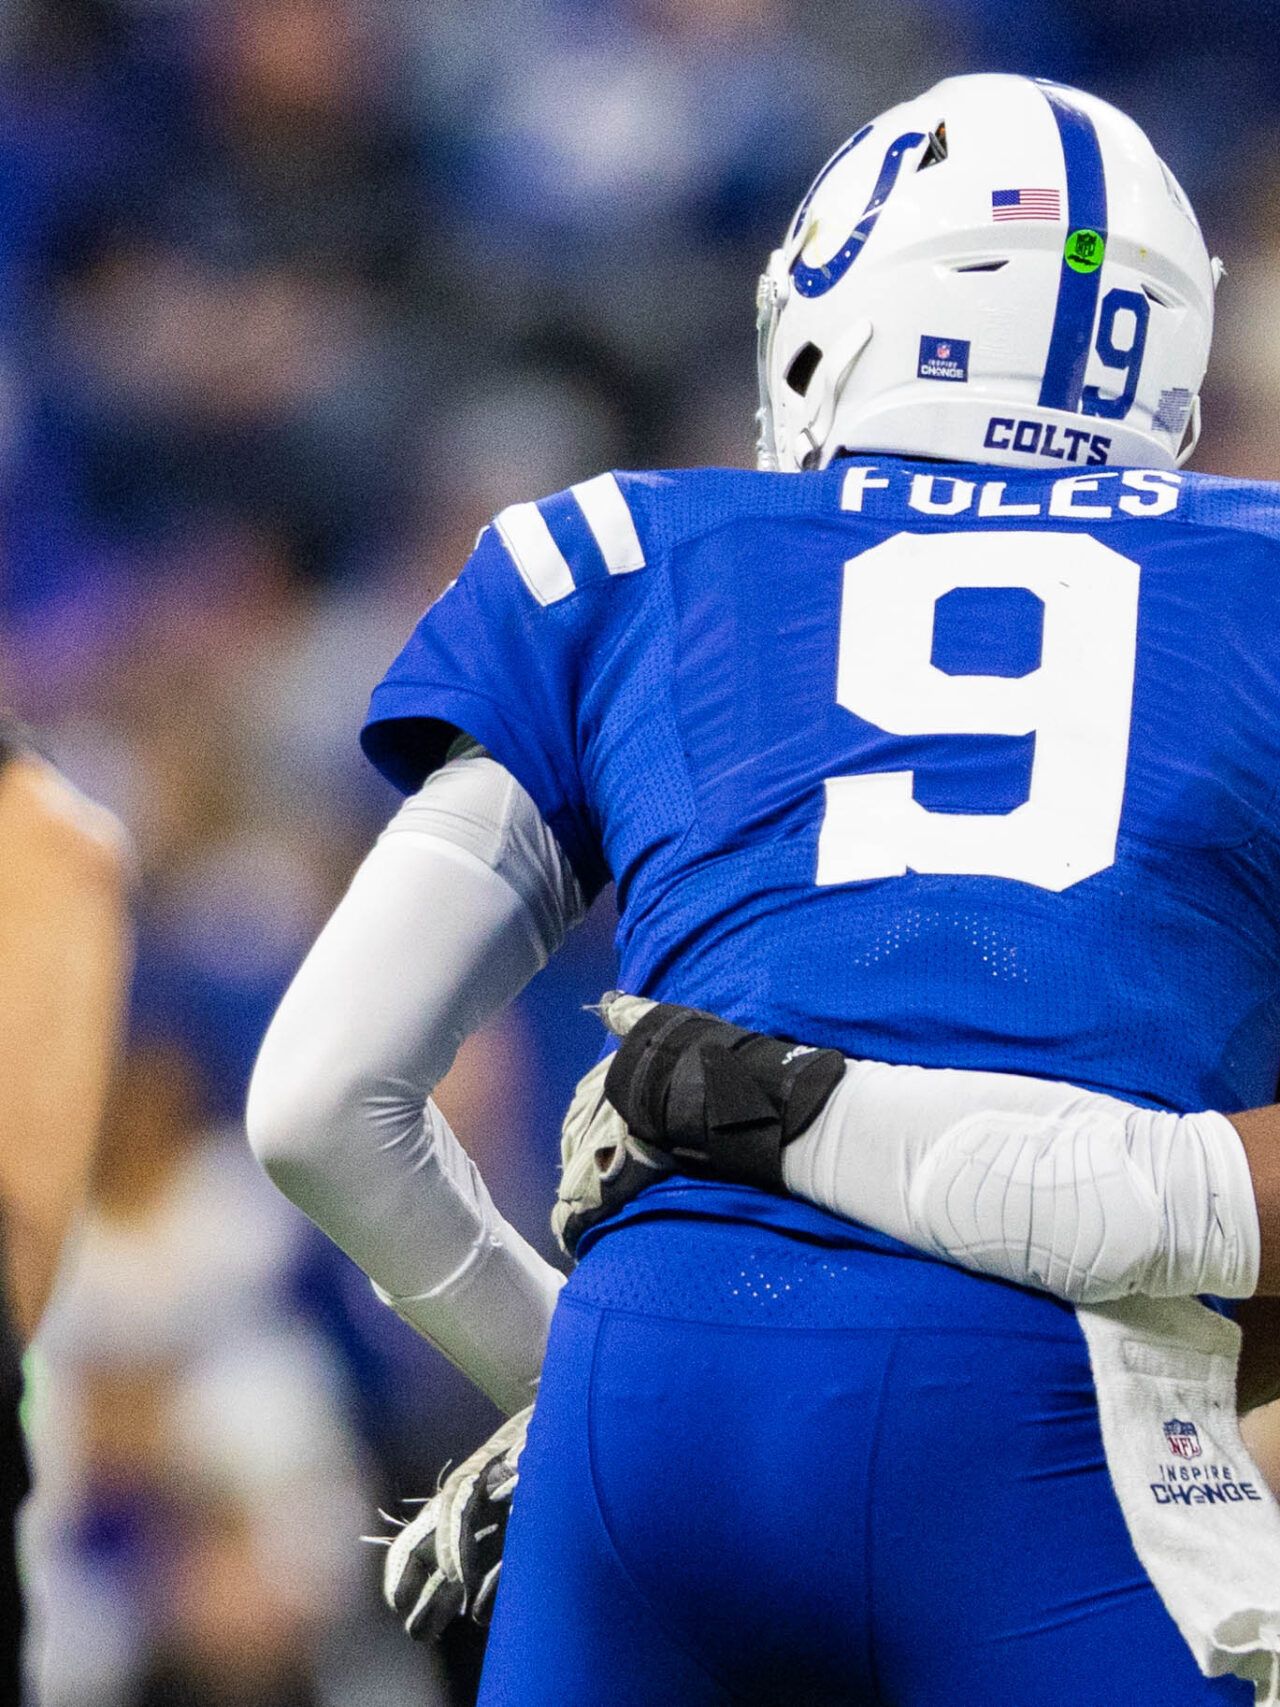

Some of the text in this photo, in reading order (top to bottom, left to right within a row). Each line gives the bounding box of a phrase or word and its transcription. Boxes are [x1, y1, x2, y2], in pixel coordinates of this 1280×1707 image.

[1080, 288, 1151, 420] 9
[983, 416, 1112, 466] COLTS
[840, 466, 1184, 519] FOLES
[815, 530, 1142, 893] 9
[1168, 1436, 1200, 1457] NFL
[1150, 1482, 1262, 1505] CHANGE
[1160, 1463, 1232, 1481] INSPIRE
